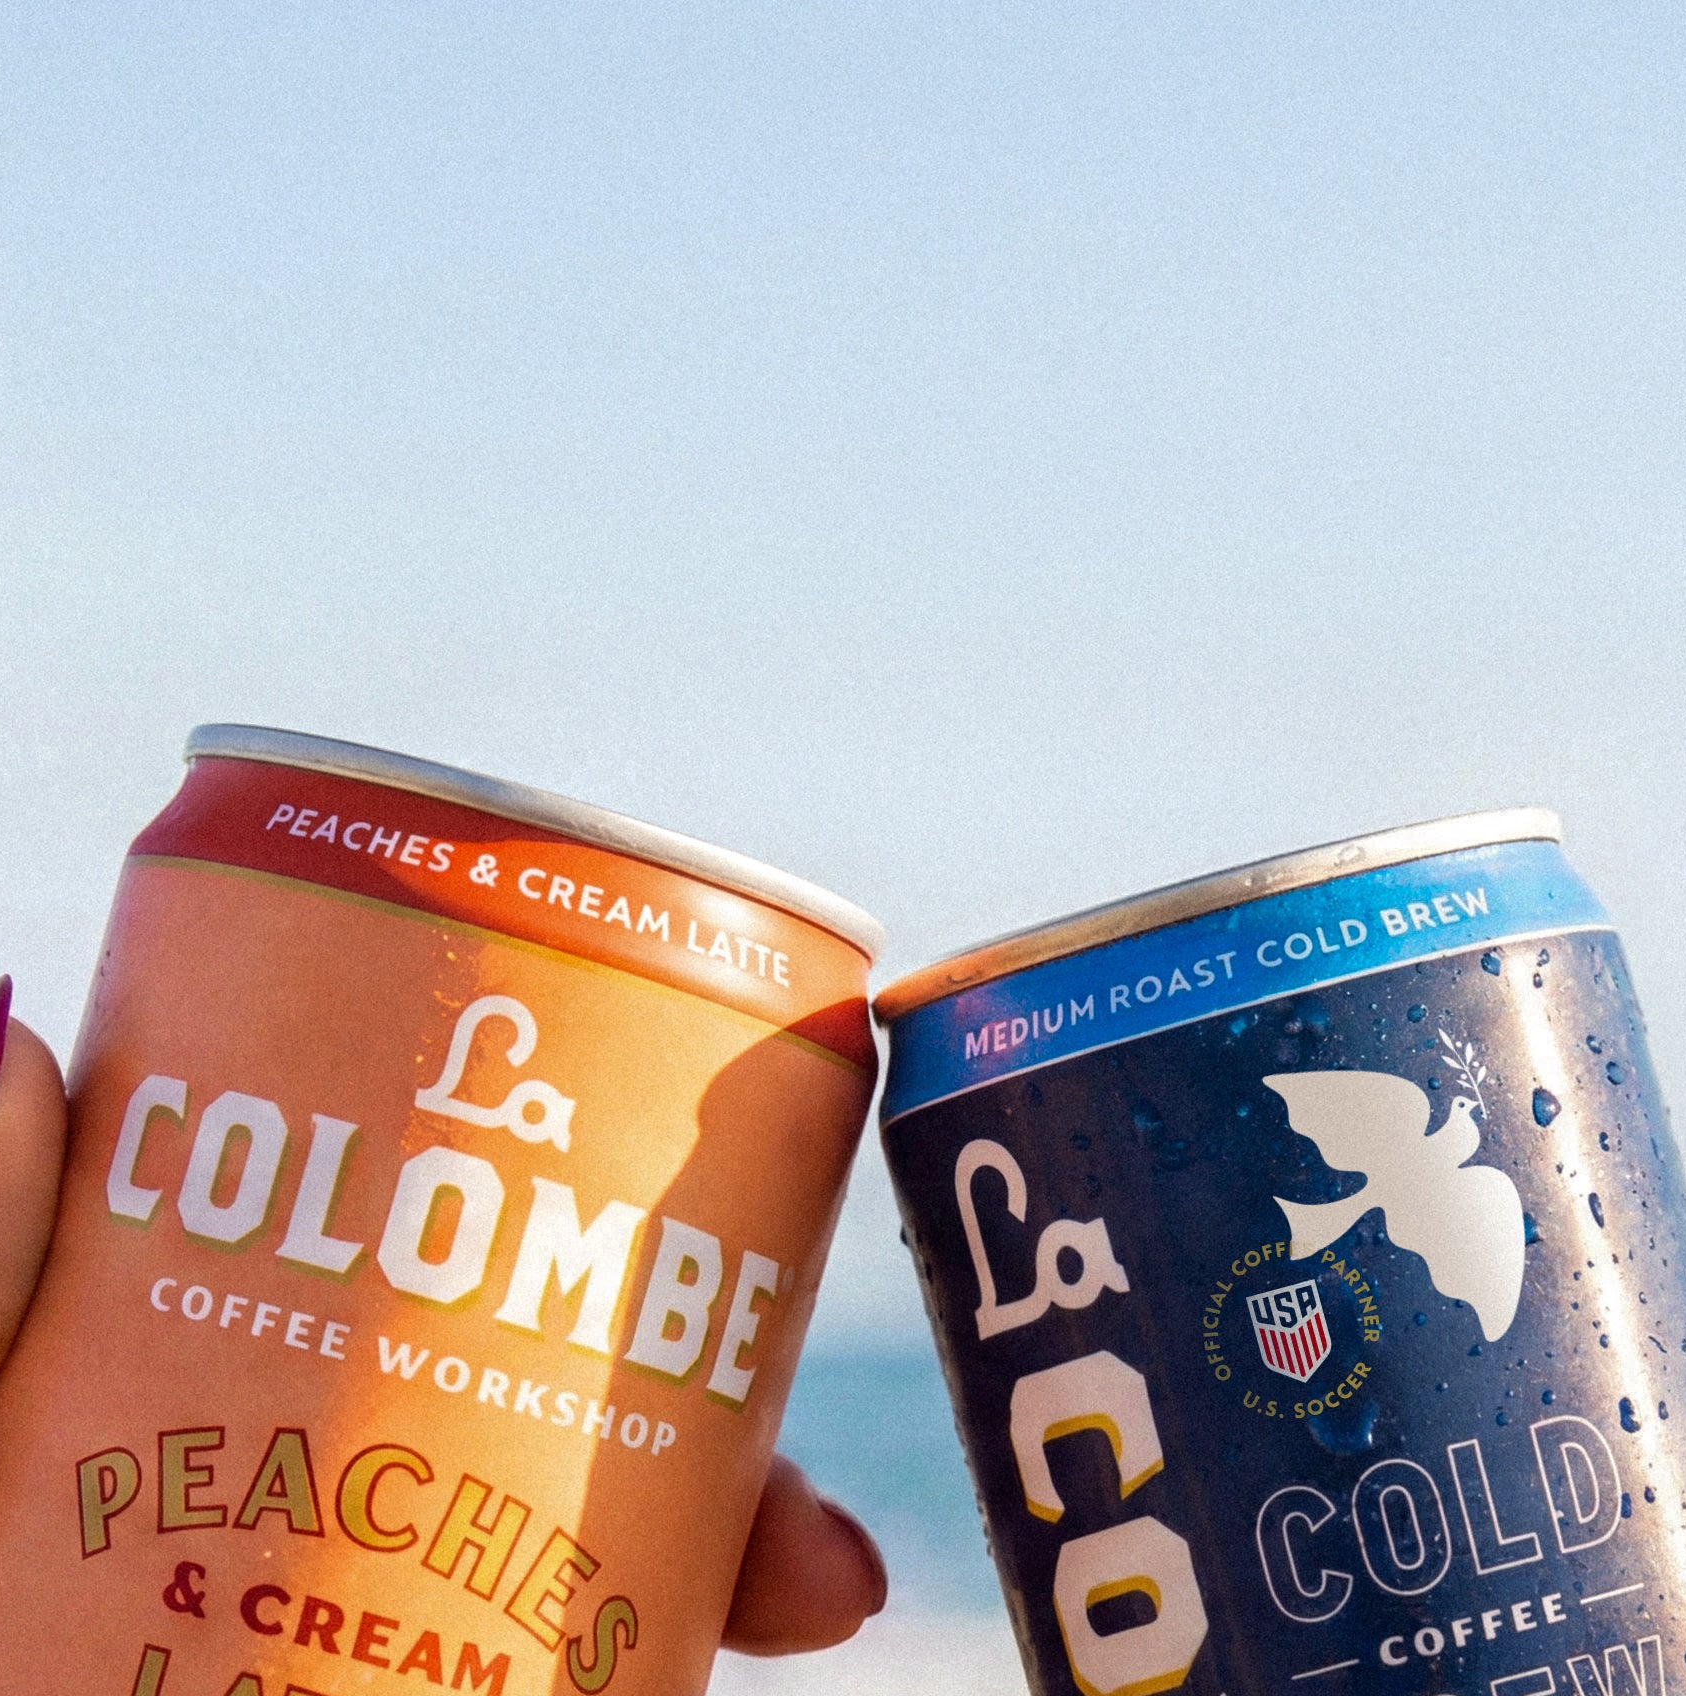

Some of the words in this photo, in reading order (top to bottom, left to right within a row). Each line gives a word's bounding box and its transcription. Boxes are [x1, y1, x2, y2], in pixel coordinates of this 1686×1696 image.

[266, 803, 454, 873] PEACHES
[470, 853, 500, 887] &
[518, 868, 669, 942] CREAM
[687, 920, 790, 988] LATTE
[965, 994, 1096, 1061] MEDIUM
[1109, 950, 1237, 1014] ROAST
[1255, 919, 1368, 969] COLD
[1380, 887, 1490, 938] BREW
[415, 994, 576, 1153] La
[106, 1074, 782, 1409] COLOMBE
[954, 1138, 1131, 1342] La
[1203, 1280, 1234, 1381] OFFICIAL
[1320, 1250, 1380, 1342] PARTNER
[1251, 1284, 1317, 1328] USA
[150, 1277, 352, 1360] COFFEE
[378, 1336, 678, 1456] WORKSHOP
[1242, 1391, 1284, 1419] U.S.
[1294, 1361, 1372, 1419] SOCCER
[76, 1426, 638, 1695] PEACHES
[162, 1561, 207, 1618] &
[1255, 1414, 1623, 1623] COLD
[1378, 1592, 1567, 1667] COFFEE
